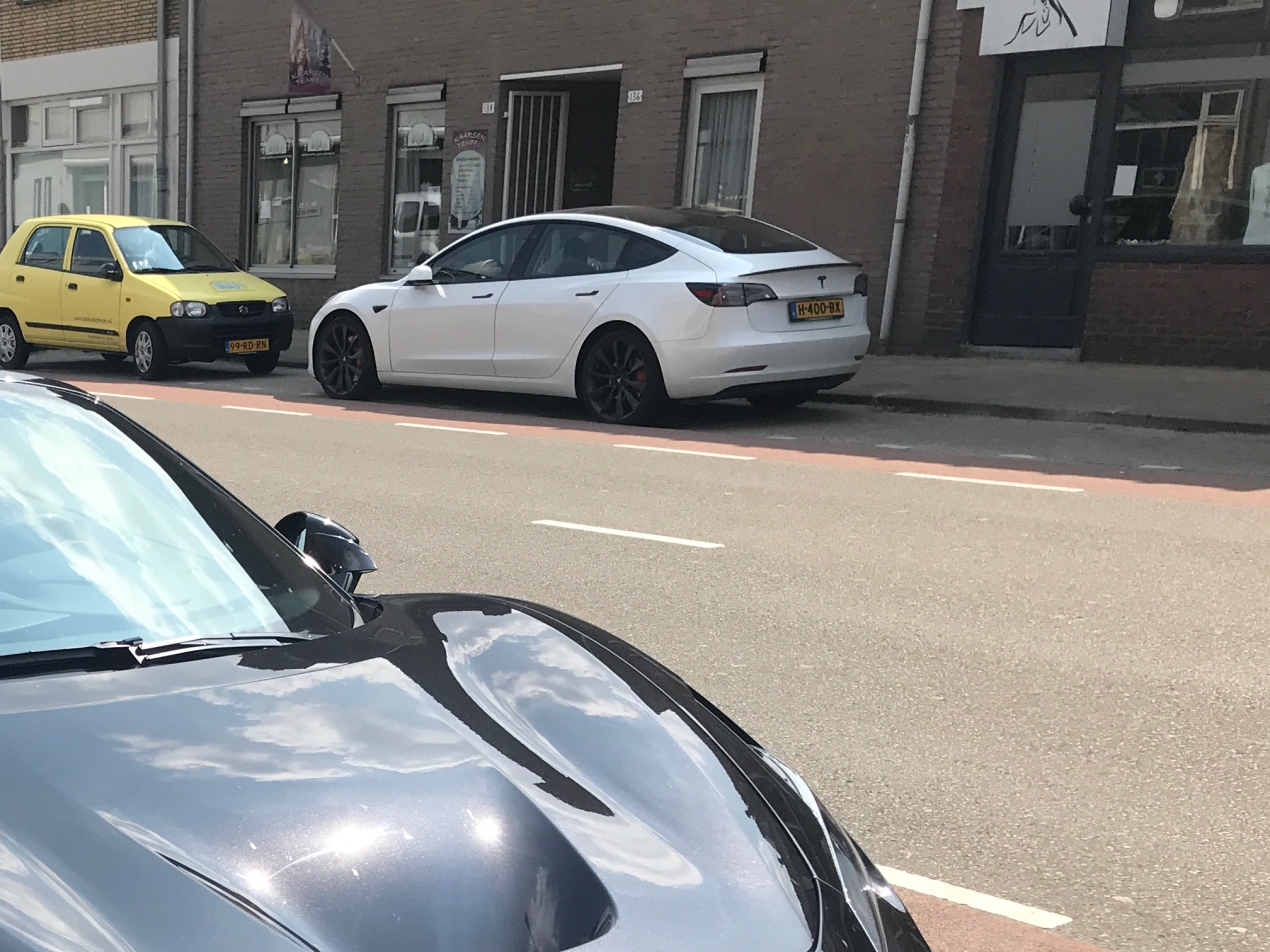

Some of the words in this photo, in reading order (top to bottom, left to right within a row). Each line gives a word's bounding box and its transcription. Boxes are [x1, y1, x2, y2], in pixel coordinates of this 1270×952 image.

[454, 131, 486, 143] KAARSEN
[798, 301, 841, 316] H-400-BX
[230, 340, 267, 351] 99-RD-RN
